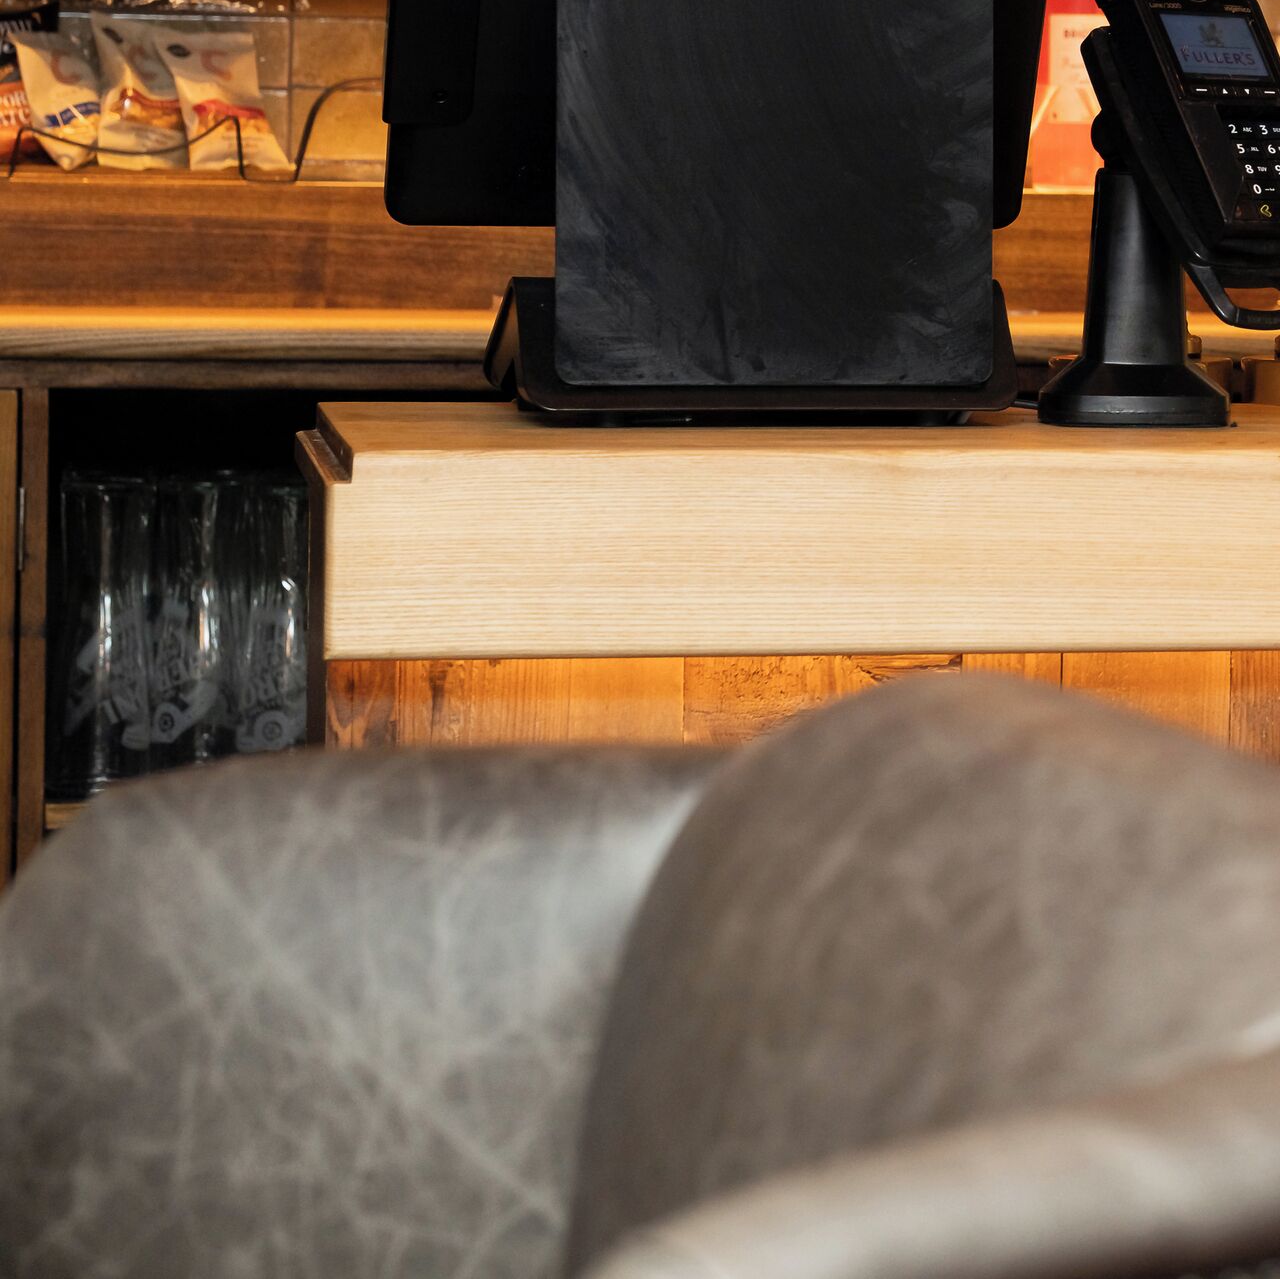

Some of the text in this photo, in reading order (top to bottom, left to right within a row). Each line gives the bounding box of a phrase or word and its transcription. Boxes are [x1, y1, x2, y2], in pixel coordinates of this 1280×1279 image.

[1180, 47, 1256, 66] FULLER'S
[1228, 124, 1238, 133] 2
[1259, 124, 1268, 135] 3
[1236, 143, 1245, 154] 5
[1267, 144, 1276, 154] 6
[1244, 164, 1254, 174] 8
[1253, 184, 1262, 194] 0
